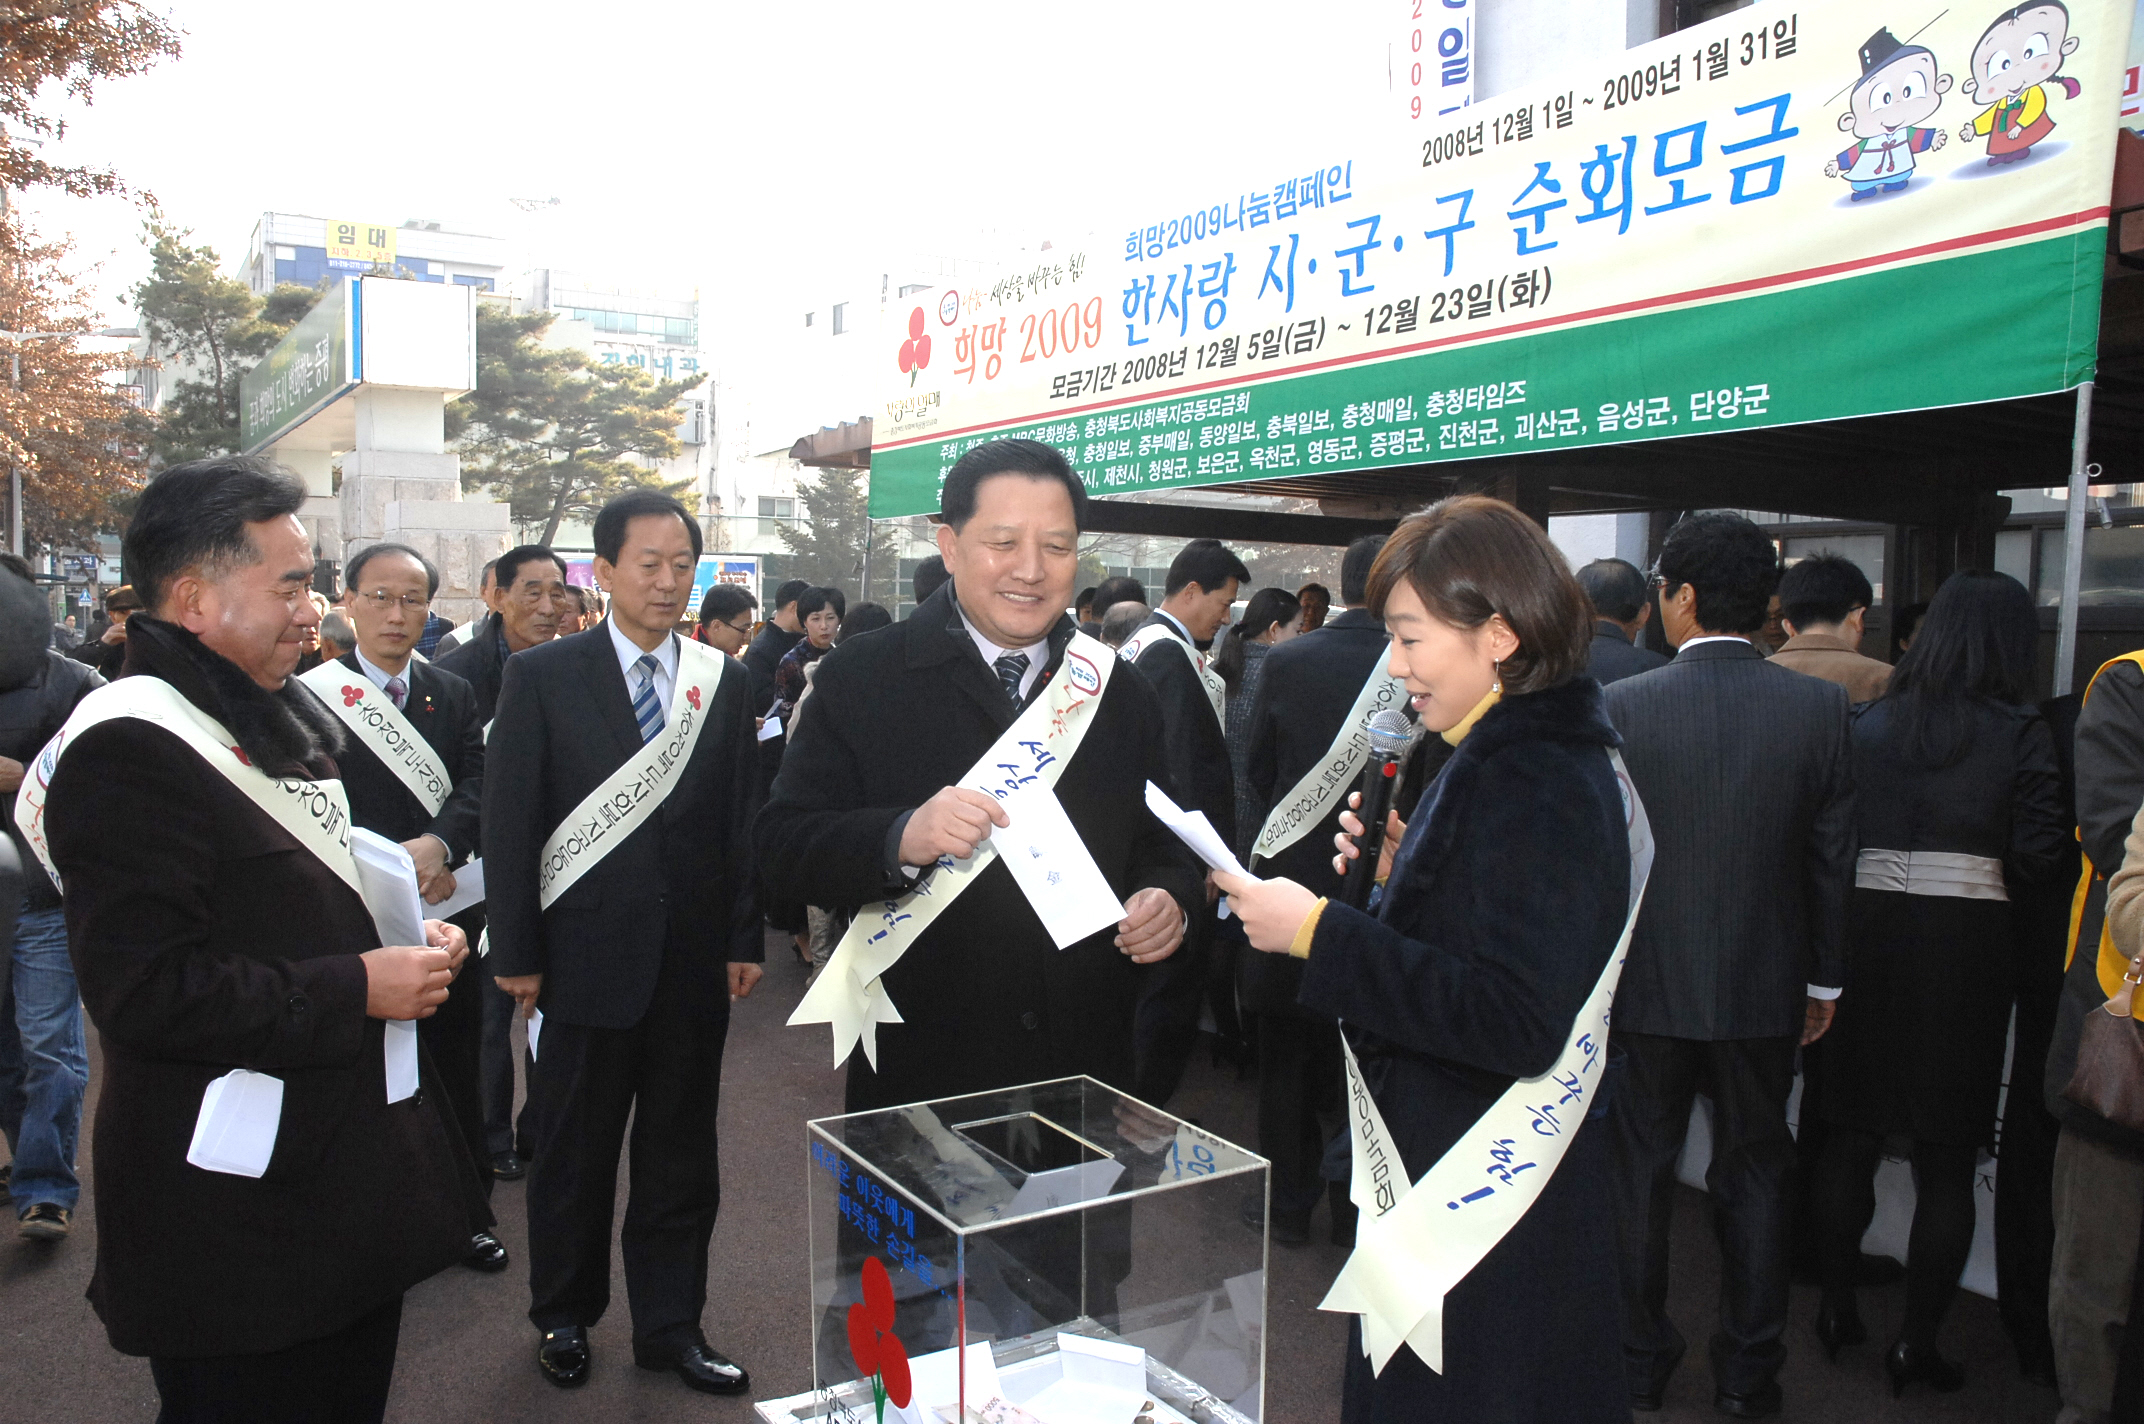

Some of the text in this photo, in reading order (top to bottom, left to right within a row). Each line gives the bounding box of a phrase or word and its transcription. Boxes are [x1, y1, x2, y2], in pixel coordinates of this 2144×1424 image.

[1422, 120, 1484, 166] 2008년
[1492, 104, 1534, 144] 12월
[1542, 90, 1573, 130] 1일
[1604, 54, 1681, 110] 2009년
[1693, 37, 1729, 80] 1월
[1740, 13, 1798, 66] 31일
[1122, 252, 1237, 346] 한사랑
[1507, 93, 1799, 255] 순회모금
[1125, 160, 1352, 261] 희망2009나눔캠페인
[990, 274, 1025, 306] 세상을
[1028, 265, 1063, 294] 바꾸는
[1050, 362, 1117, 399] 모금기간
[1121, 346, 1187, 385] 2008년
[1196, 335, 1240, 370] 12월
[1246, 316, 1326, 361] 5일(금)
[1364, 295, 1420, 336] 12월
[1429, 266, 1552, 324] 23일(화)
[276, 371, 287, 413] 도시
[315, 333, 330, 388] 증평
[954, 296, 1102, 384] 희망 2009
[1083, 439, 1134, 463] 충청일보,
[1138, 429, 1194, 456] 중부매일,
[1199, 420, 1260, 448] 동양일보,
[1267, 409, 1335, 439] 충북일보,
[1341, 395, 1418, 429] 충청매일,
[1426, 380, 1526, 417] 충청타임즈
[1084, 391, 1250, 439] 충청북도사회복지공동모금회
[1103, 463, 1144, 487] 제천시,
[1148, 457, 1192, 482] 청원군,
[1196, 450, 1244, 475] 보은군,
[1249, 444, 1300, 469] 옥천군,
[1307, 436, 1362, 464] 영동군,
[1369, 427, 1430, 457] 증평군,
[1438, 418, 1505, 449] 진천군,
[1514, 408, 1588, 441] 괴산군,
[1597, 396, 1678, 433] 음성군,
[1690, 383, 1770, 421] 단양군
[1446, 1033, 1599, 1211] 바꾸는 힘!
[811, 1141, 850, 1188] 어려운
[856, 1174, 915, 1239] 이웃에게
[838, 1192, 879, 1244] 따뜻한
